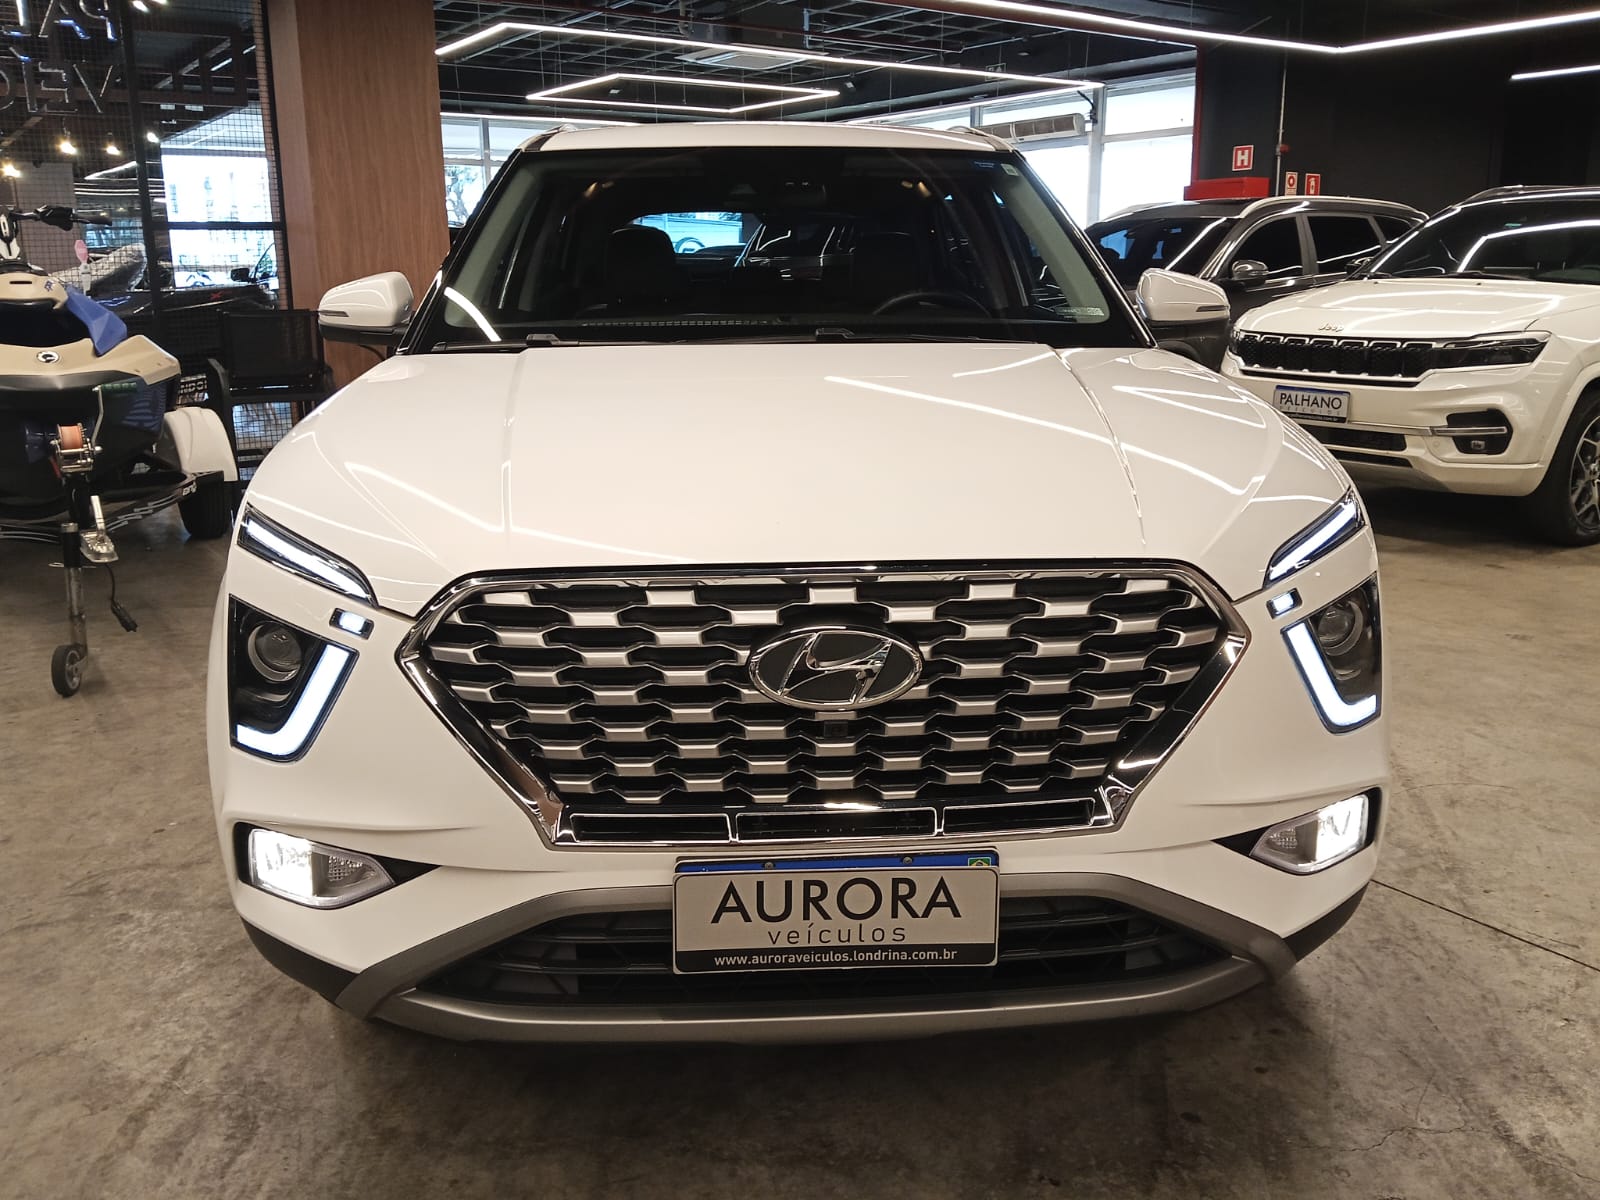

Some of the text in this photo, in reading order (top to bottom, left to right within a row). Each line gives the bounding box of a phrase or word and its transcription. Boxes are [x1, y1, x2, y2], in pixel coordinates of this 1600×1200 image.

[1236, 149, 1249, 167] H
[1318, 322, 1344, 333] Jeep
[1279, 392, 1342, 410] PALHANO
[711, 876, 962, 924] AURORA
[768, 923, 906, 945] veículos
[714, 948, 958, 967] www.auroraveiculos.londrina.com.br
